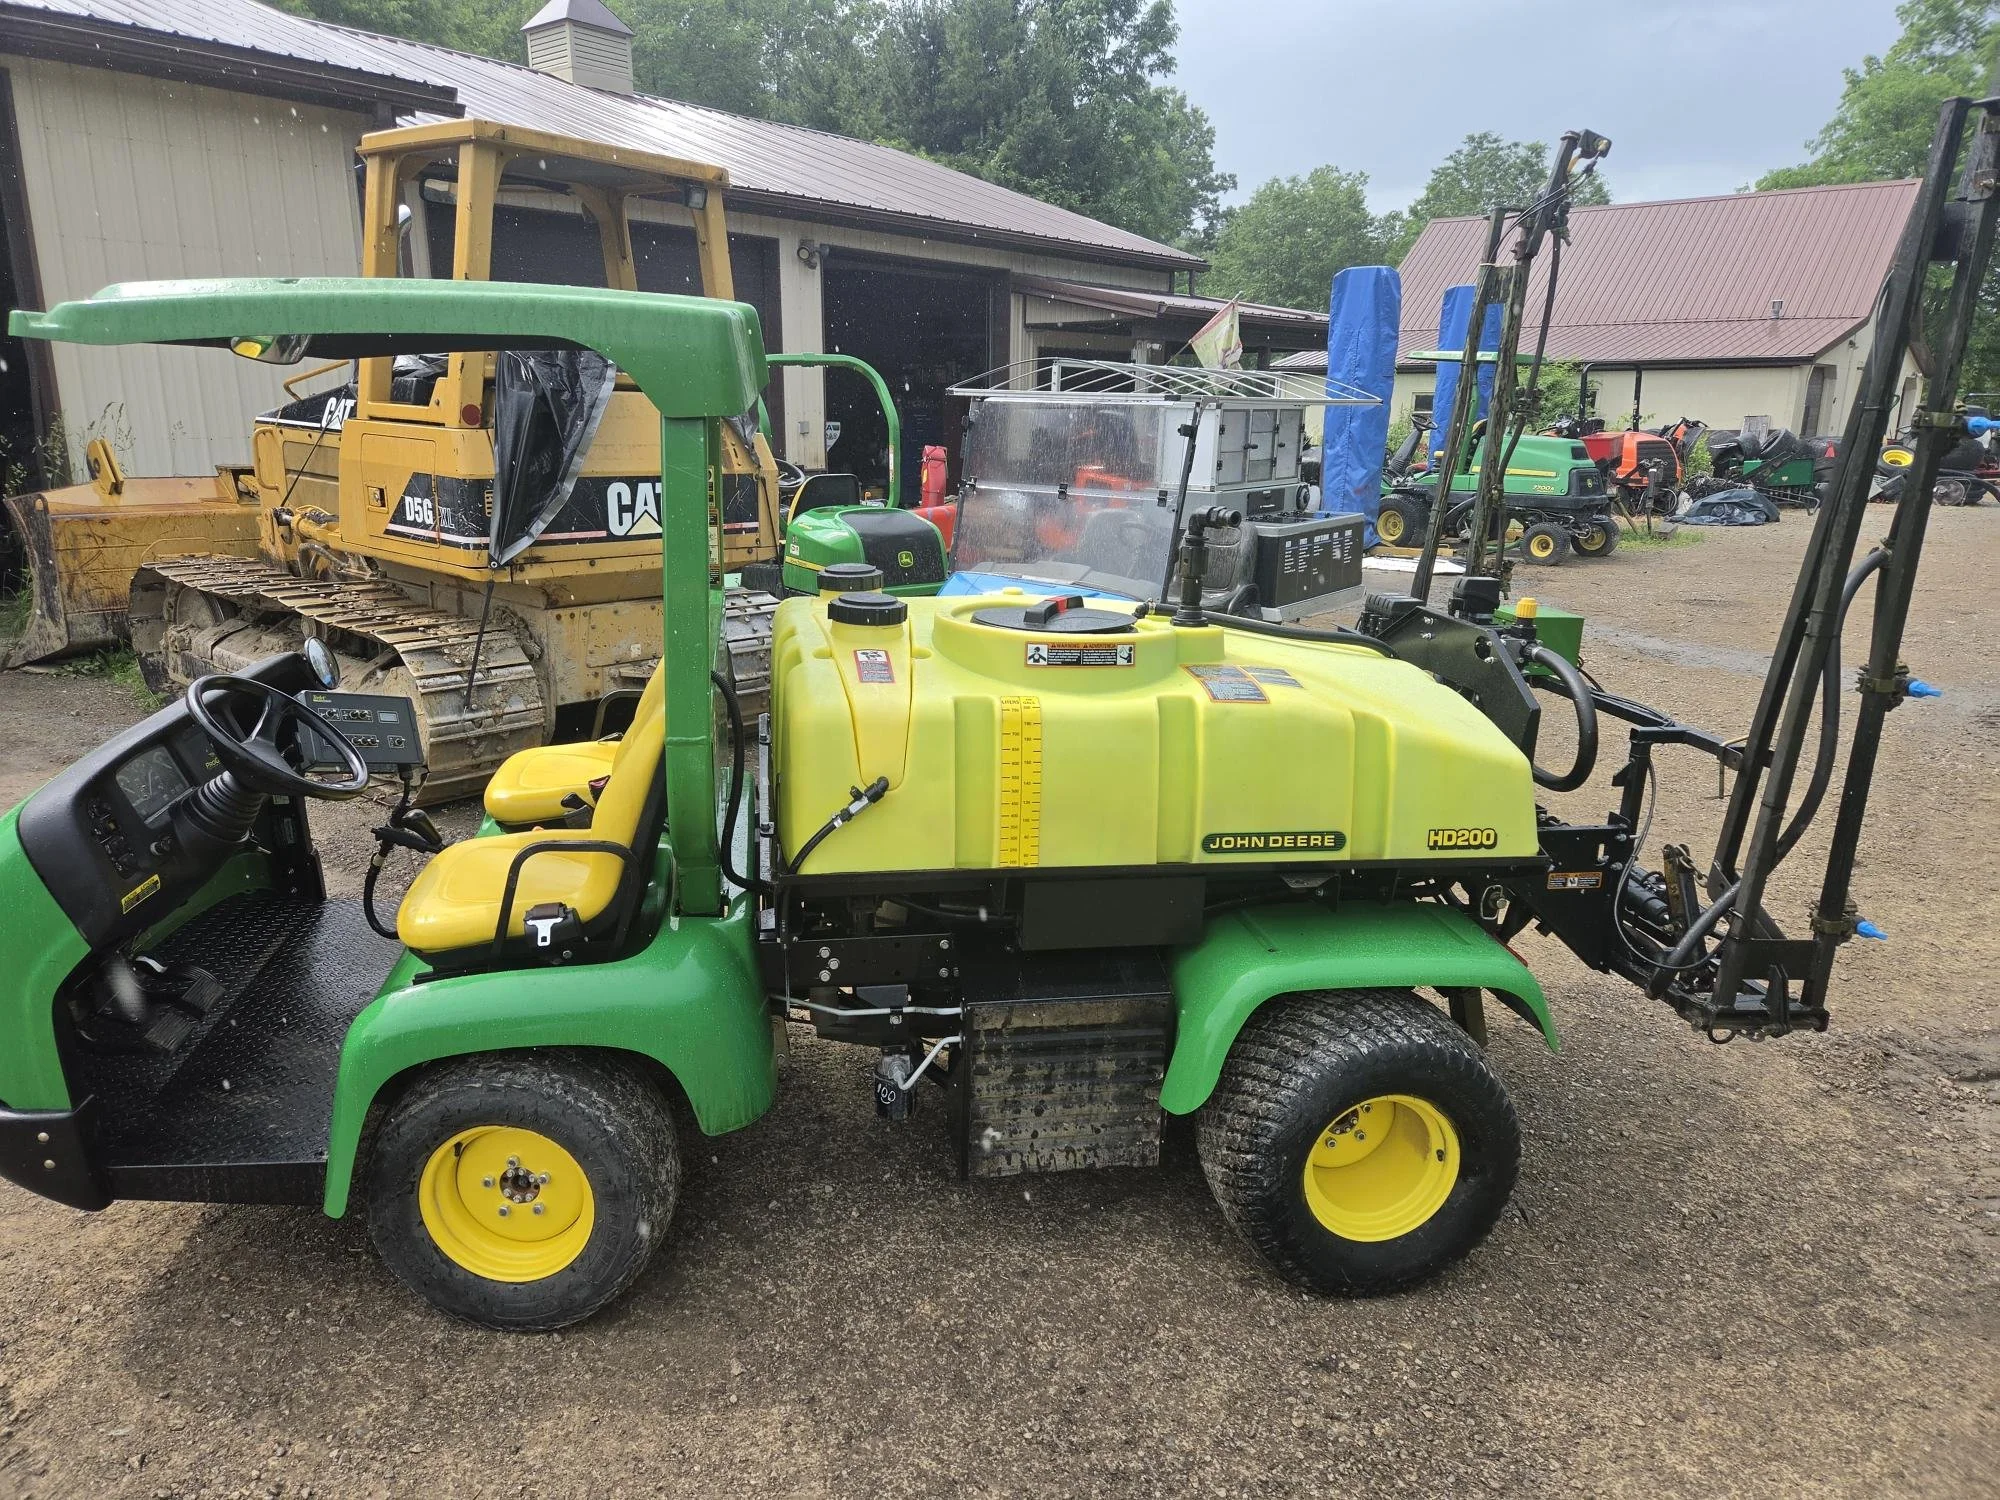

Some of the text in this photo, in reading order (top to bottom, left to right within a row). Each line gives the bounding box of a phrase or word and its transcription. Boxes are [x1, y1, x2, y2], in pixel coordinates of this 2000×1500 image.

[321, 397, 357, 429] CAT
[404, 496, 434, 525] D5G
[607, 482, 663, 536] CA
[1208, 835, 1336, 849] JOHN DEERE
[1427, 828, 1497, 850] HD200
[877, 1083, 896, 1103] 100
